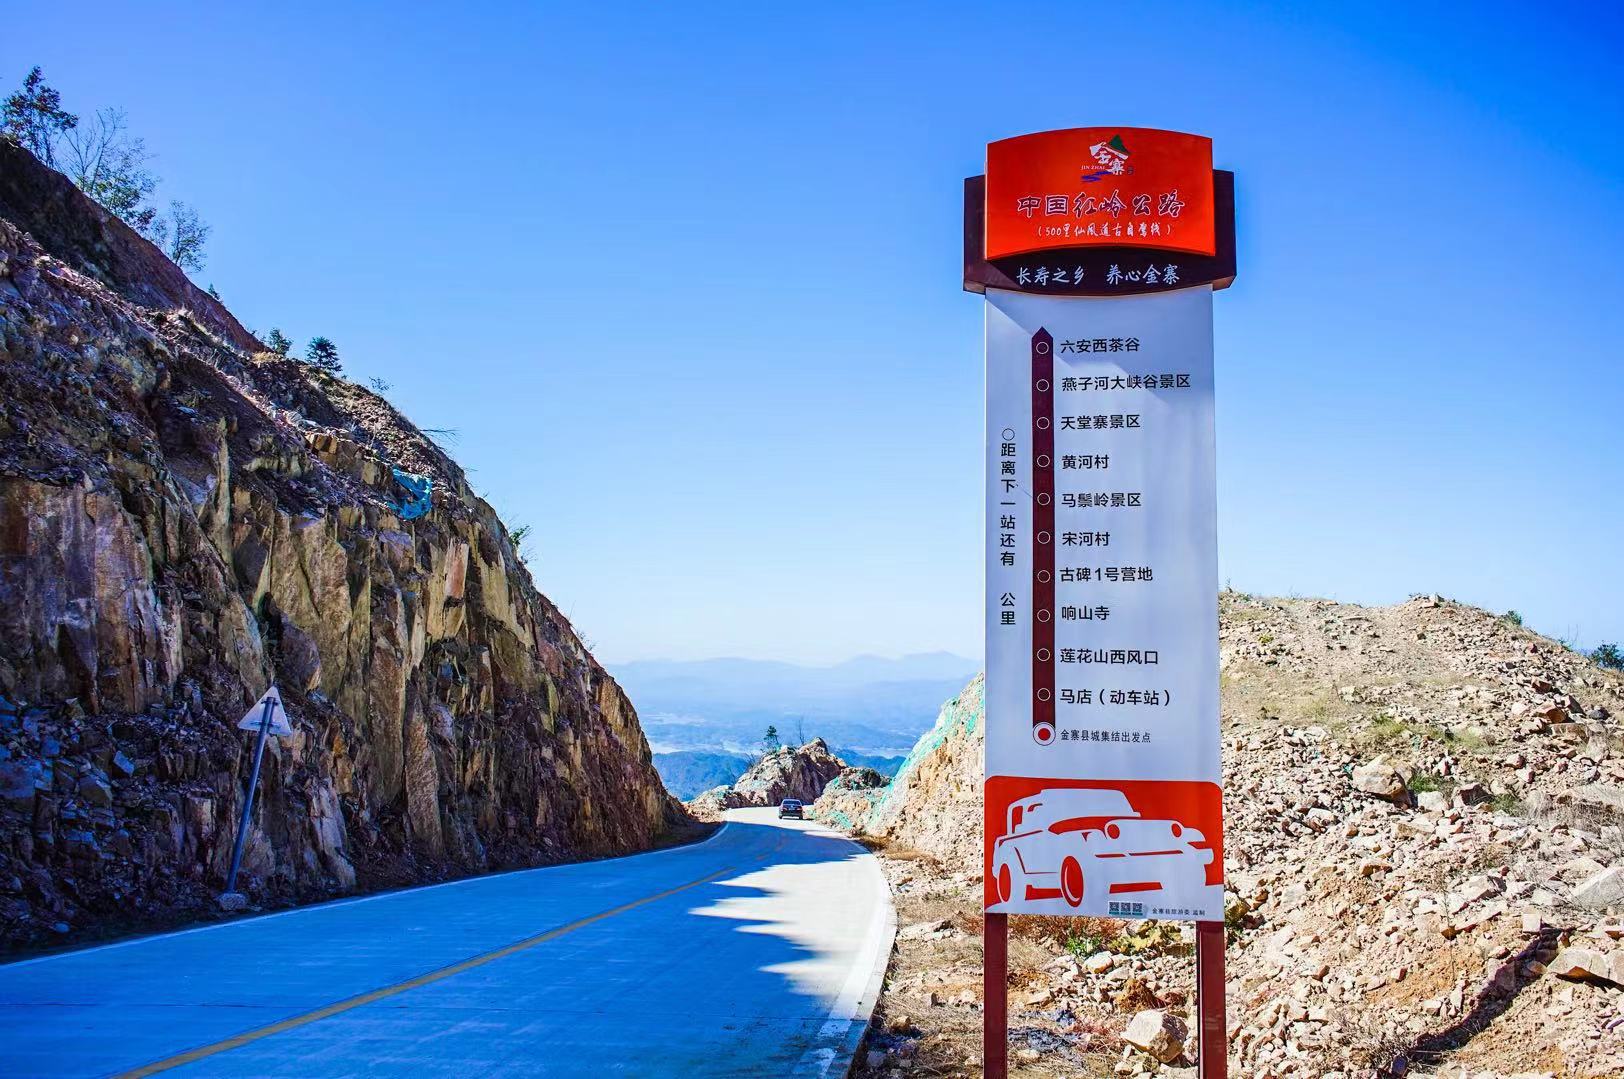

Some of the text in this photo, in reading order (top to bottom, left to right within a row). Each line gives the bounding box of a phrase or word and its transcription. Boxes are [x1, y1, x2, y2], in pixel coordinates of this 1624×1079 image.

[1017, 189, 1185, 218] 中国红岭公路
[1016, 264, 1180, 285] 长寿之乡 养心金寨
[1060, 338, 1140, 353] 六安西茶谷
[1062, 373, 1191, 391] 燕子河大峡谷景区
[1061, 415, 1140, 430] 天堂寨景区
[1062, 455, 1109, 469] 黄河村
[1062, 493, 1141, 507] 马鬃岭景区
[1000, 443, 1016, 625] 距离下一站还有 公里
[1062, 532, 1110, 546] 宋河村
[1060, 567, 1153, 582] 古碑1号营地
[1062, 606, 1109, 620] 响山寺
[1060, 648, 1158, 664] 莲花山西风口
[1061, 729, 1150, 742] 金寨县城集结出发点
